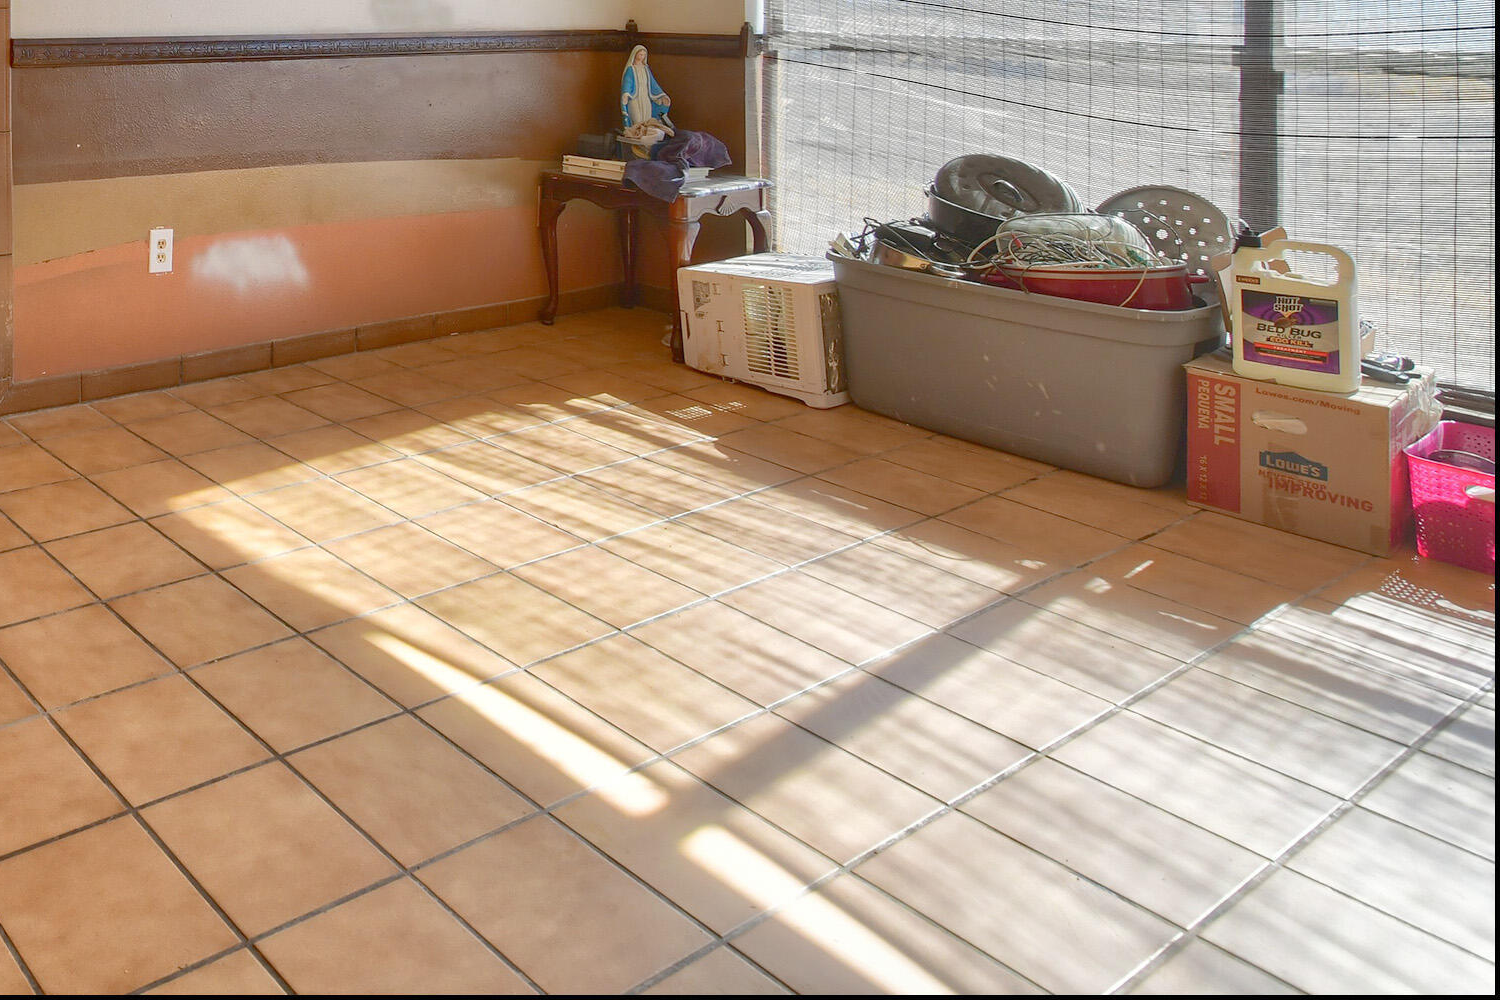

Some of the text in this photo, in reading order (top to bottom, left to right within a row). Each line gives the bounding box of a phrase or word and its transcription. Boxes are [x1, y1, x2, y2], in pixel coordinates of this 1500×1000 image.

[1274, 303, 1303, 312] SHOT
[1276, 296, 1300, 305] HOT
[1256, 323, 1322, 339] BED BUG
[1213, 383, 1236, 446] SMALL
[1299, 479, 1328, 491] STOP
[1268, 476, 1373, 512] IMPROVING
